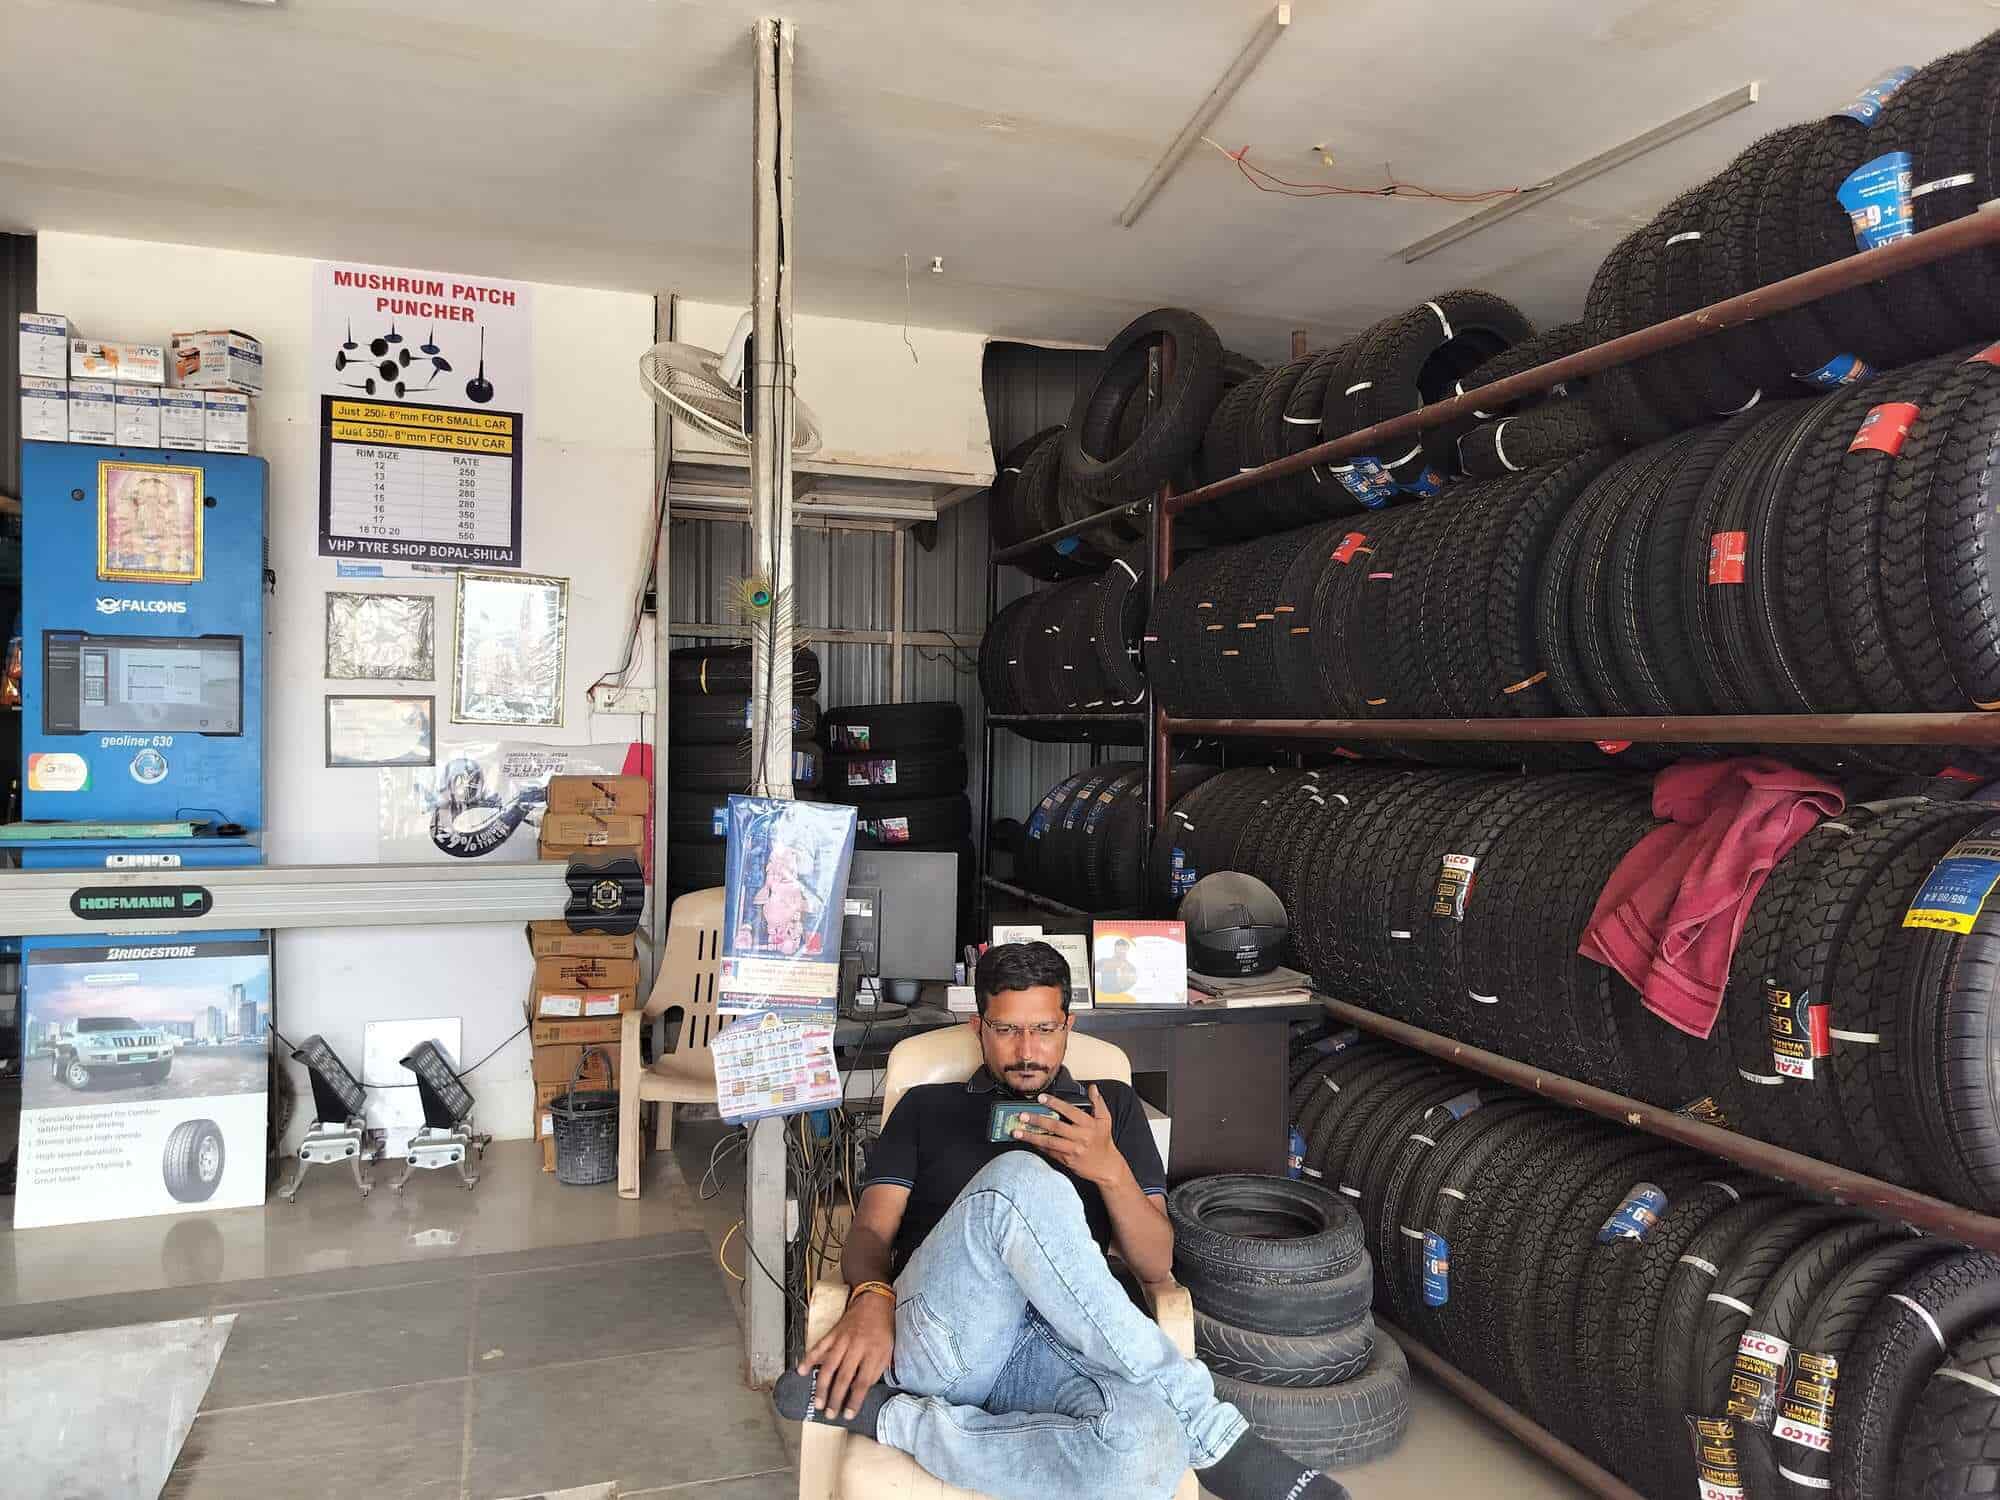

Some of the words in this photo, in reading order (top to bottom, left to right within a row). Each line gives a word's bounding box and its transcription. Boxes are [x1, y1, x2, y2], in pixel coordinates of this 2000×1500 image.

[334, 270, 444, 297] MUSHRUM
[452, 284, 516, 306] PATCH
[376, 297, 475, 323] PUNCHER
[338, 406, 360, 417] Just
[422, 413, 444, 425] FOR
[447, 416, 482, 428] SMALL
[485, 419, 506, 430] CAR
[338, 426, 363, 437] Just
[430, 433, 453, 445] FOR
[456, 436, 479, 447] SUV
[482, 439, 506, 449] CAR
[356, 448, 375, 459] RIM
[378, 451, 400, 461] SIZE
[374, 461, 385, 470] 12
[453, 456, 480, 466] RATE
[374, 472, 385, 481] 13
[459, 469, 475, 477] 250
[374, 483, 385, 492] 14
[459, 479, 475, 488] 250
[374, 494, 385, 502] 15
[374, 515, 385, 524] 17
[458, 511, 475, 519] 350
[458, 521, 475, 530] 450
[372, 526, 386, 535] TO
[389, 527, 400, 536] 20
[458, 532, 475, 541] 550
[328, 539, 354, 551] VHP
[358, 541, 389, 554] TYRE
[392, 543, 427, 556] SHOP
[122, 600, 187, 613] FALCONS
[152, 736, 173, 746] 630
[80, 896, 175, 910] HOFMANN
[107, 946, 196, 961] BRIDGESTONE
